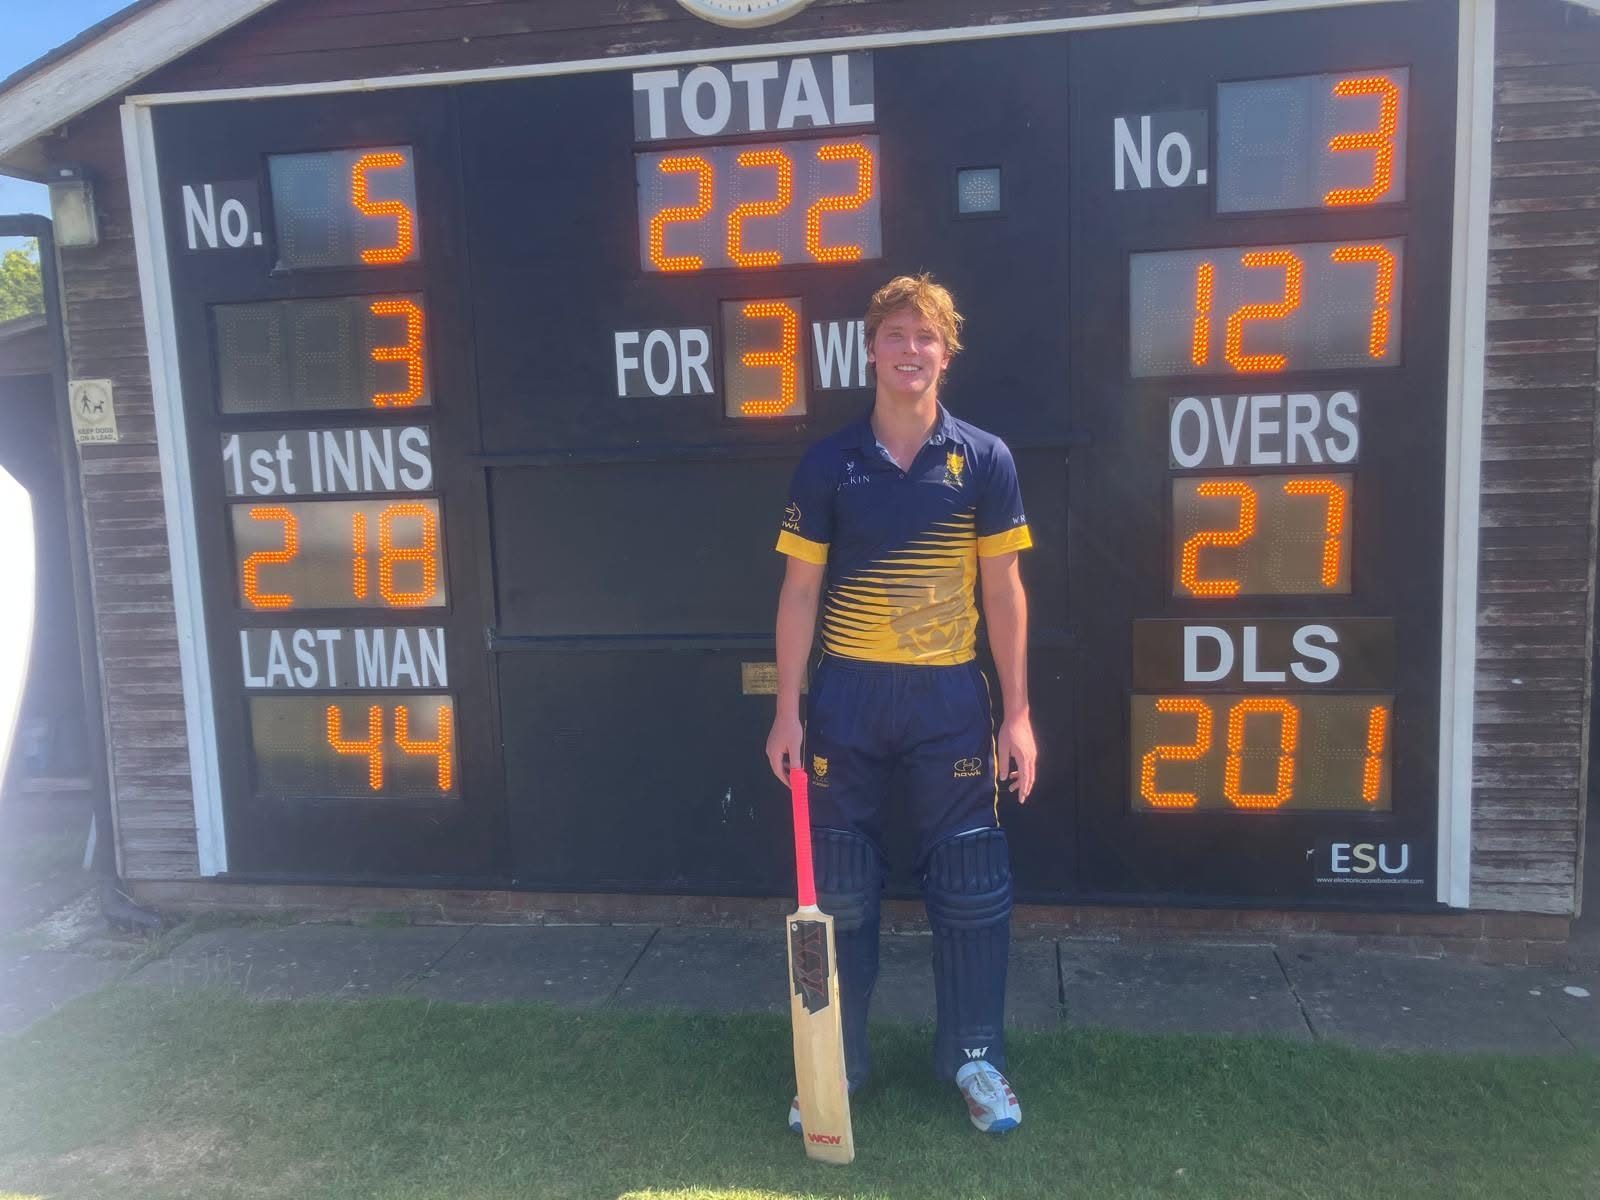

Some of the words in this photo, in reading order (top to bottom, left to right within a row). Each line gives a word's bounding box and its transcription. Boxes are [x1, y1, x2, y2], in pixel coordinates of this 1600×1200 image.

[633, 54, 875, 139] TOTAL
[1114, 115, 1207, 190] No.
[1325, 77, 1399, 206] 3
[182, 183, 262, 249] No.
[353, 153, 413, 263] 5
[650, 144, 874, 271] 222
[1192, 245, 1395, 372] 127
[371, 301, 424, 406] 3
[614, 329, 714, 396] FOR
[741, 303, 798, 415] 3
[222, 434, 297, 496] 1st
[308, 426, 433, 493] INNS
[1170, 391, 1359, 468] OVERS
[1181, 480, 1345, 594] 27
[239, 628, 342, 689] LAST
[353, 627, 448, 688] MAN
[1183, 624, 1340, 683] DLS
[327, 706, 452, 790] 44
[1331, 843, 1408, 874] ESU
